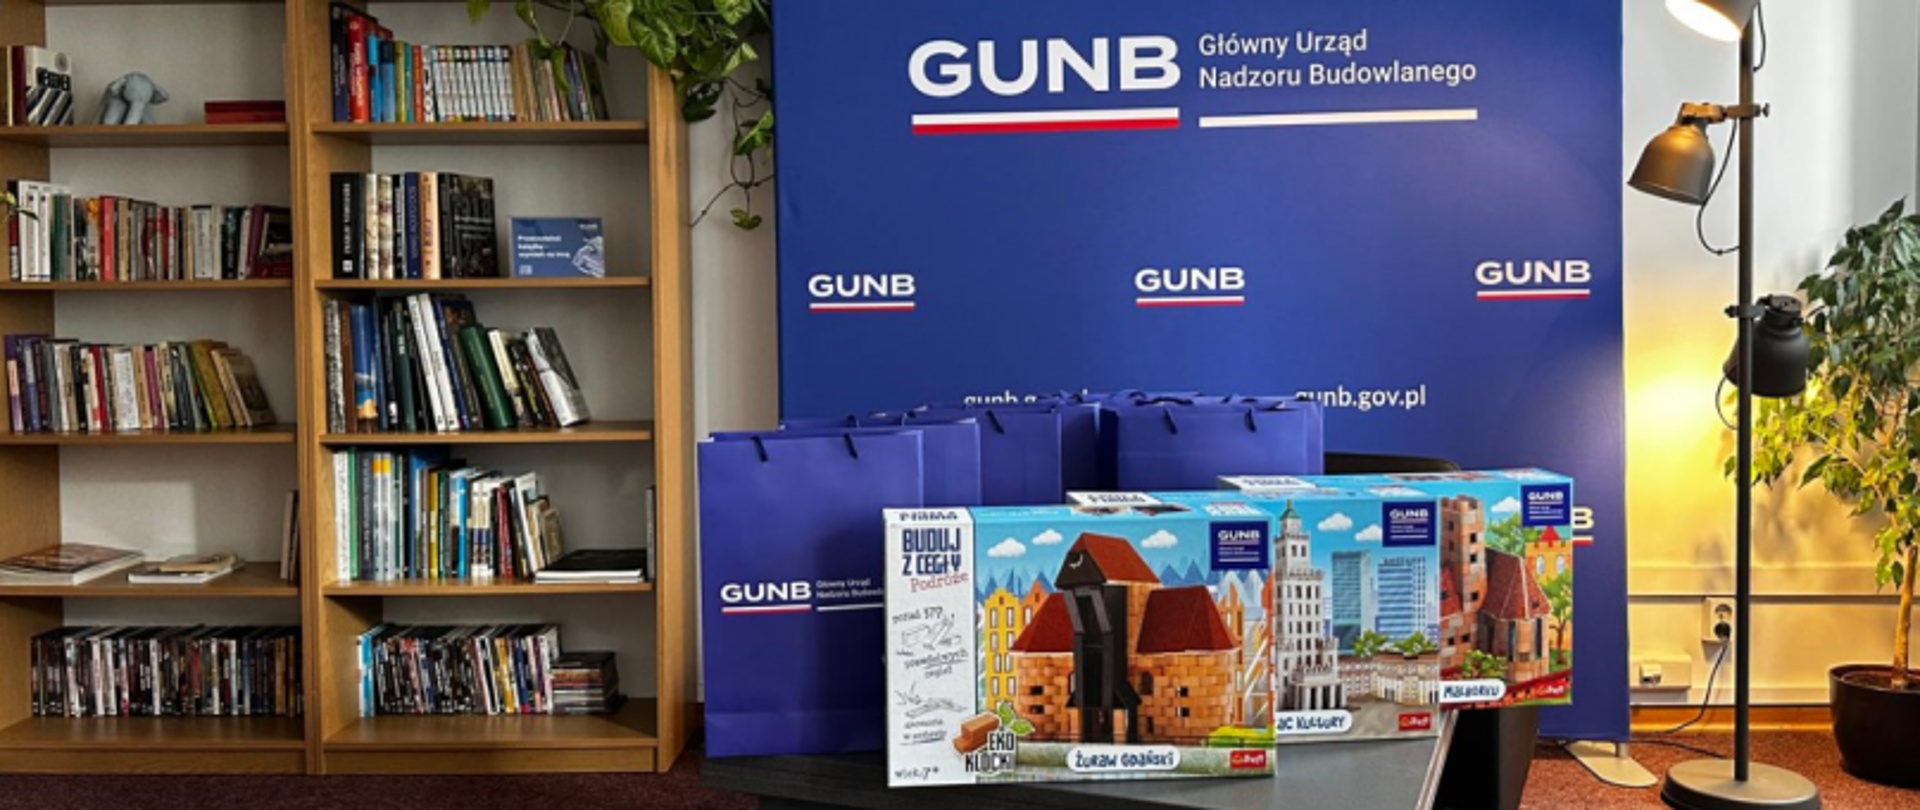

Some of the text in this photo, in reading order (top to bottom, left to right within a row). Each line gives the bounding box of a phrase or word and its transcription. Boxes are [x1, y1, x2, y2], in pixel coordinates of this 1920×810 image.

[1199, 29, 1367, 57] Główny Urząd
[908, 36, 1181, 97] GUNB
[1199, 60, 1477, 88] Nadzoru Budowlanego
[808, 273, 916, 298] GUNB
[1134, 267, 1245, 293] GUNB
[1475, 260, 1591, 286] GUNB
[1389, 508, 1429, 520] GUNB
[902, 527, 962, 552] BUDUJ
[1218, 529, 1261, 541] GUNB
[901, 554, 912, 575] Z
[720, 581, 812, 603] GUNB
[989, 733, 1015, 751] EKO
